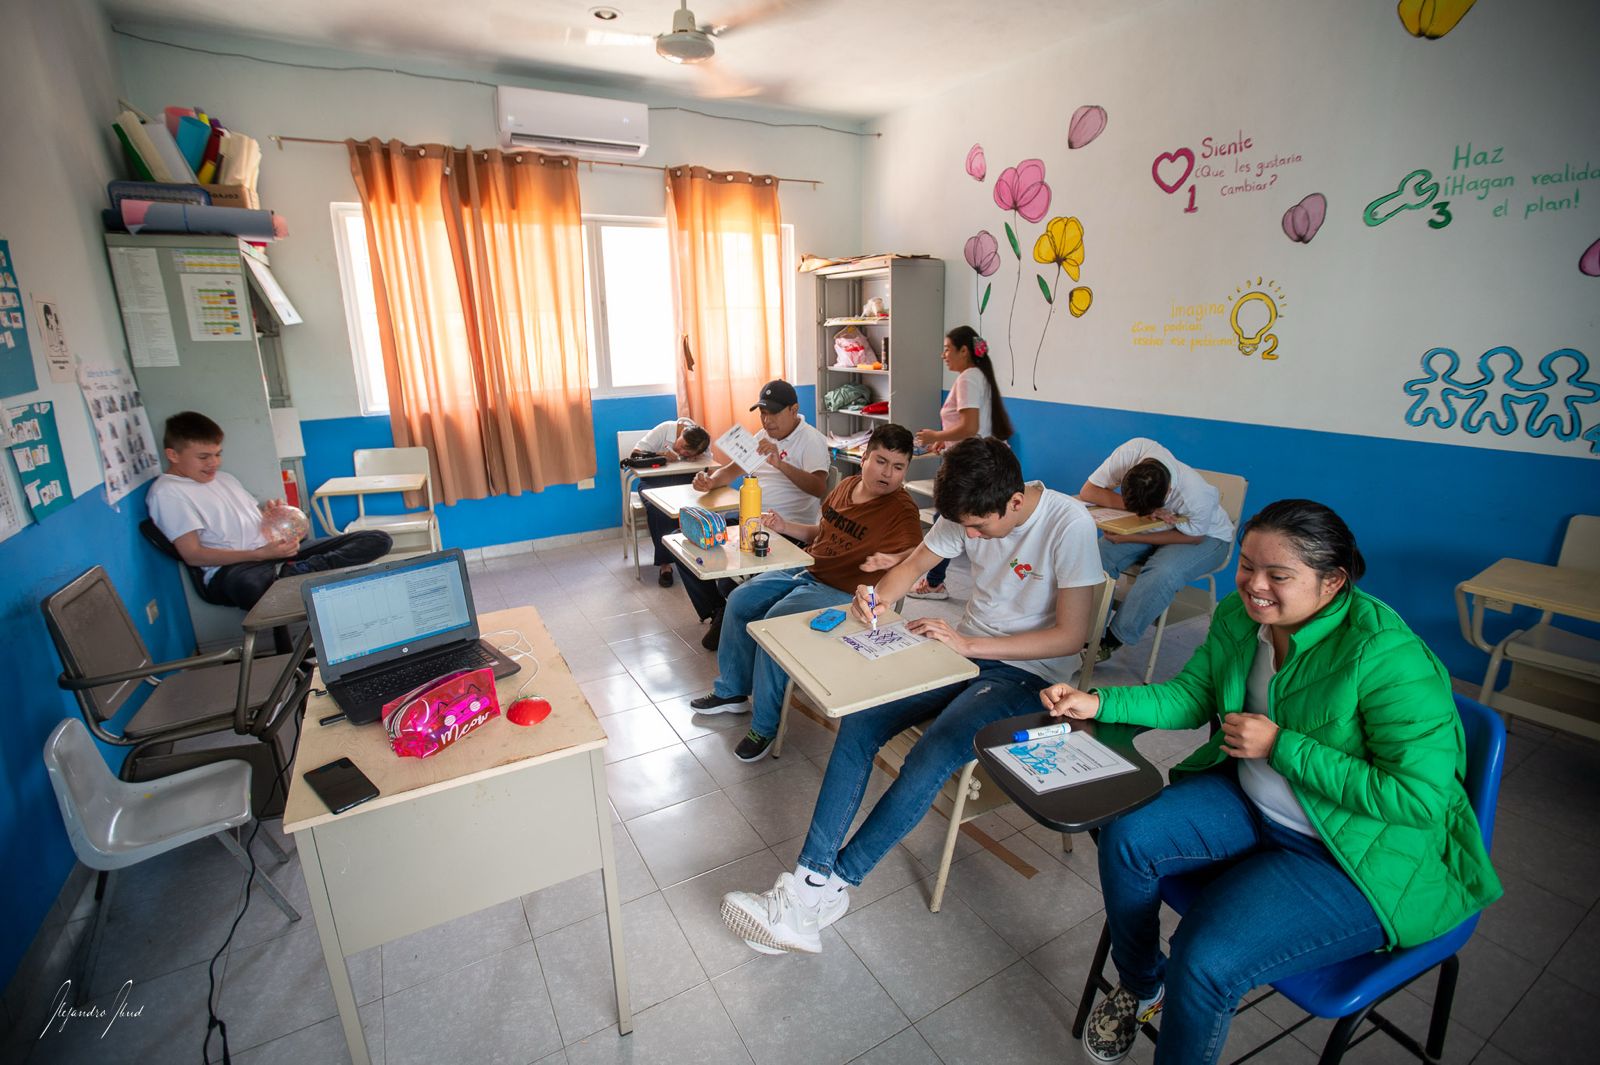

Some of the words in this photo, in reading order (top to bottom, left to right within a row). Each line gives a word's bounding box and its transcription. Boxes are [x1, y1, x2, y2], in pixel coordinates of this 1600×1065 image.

[1201, 129, 1254, 159] Siente
[1452, 141, 1505, 171] Haz
[1234, 159, 1252, 174] les
[1183, 183, 1199, 214] 1
[1220, 173, 1279, 197] cambiar?
[1427, 200, 1454, 230] 3
[1492, 197, 1509, 218] el
[1523, 187, 1581, 220] plan!
[1261, 333, 1280, 361] 2
